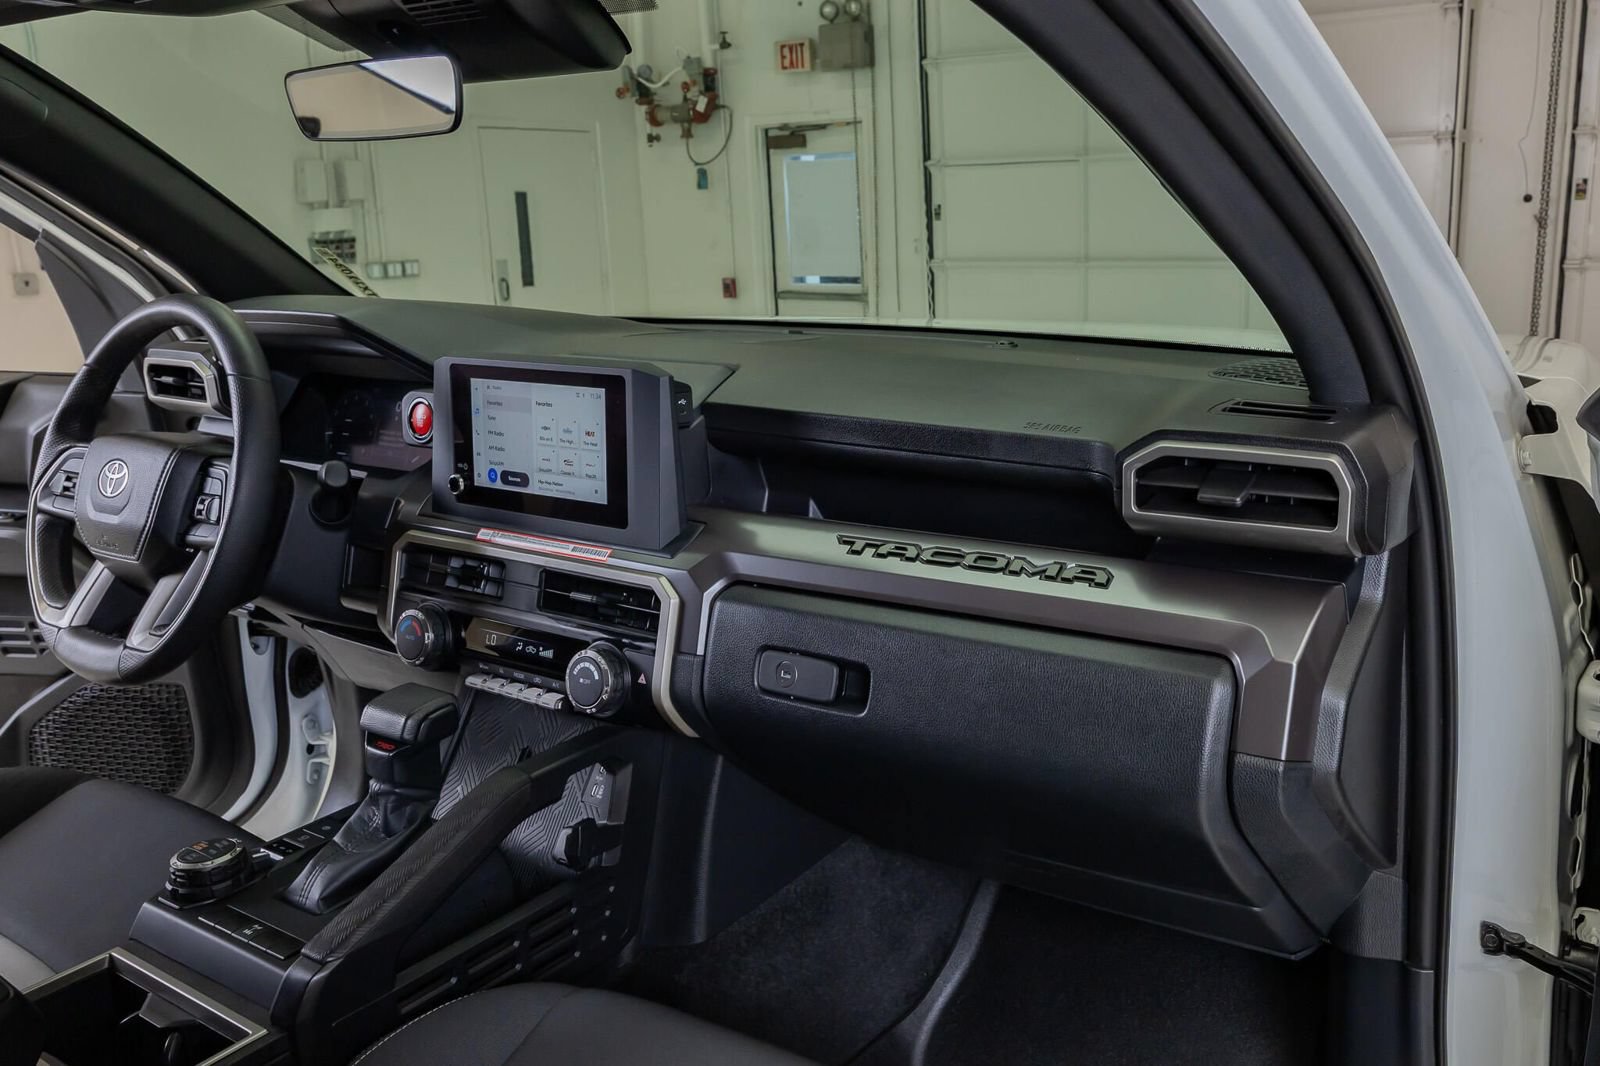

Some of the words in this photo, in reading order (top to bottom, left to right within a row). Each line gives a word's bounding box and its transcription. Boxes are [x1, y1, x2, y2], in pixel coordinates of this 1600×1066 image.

[780, 42, 805, 70] EXIT
[1041, 423, 1081, 434] AIRBAG
[836, 534, 1115, 589] TACOMA
